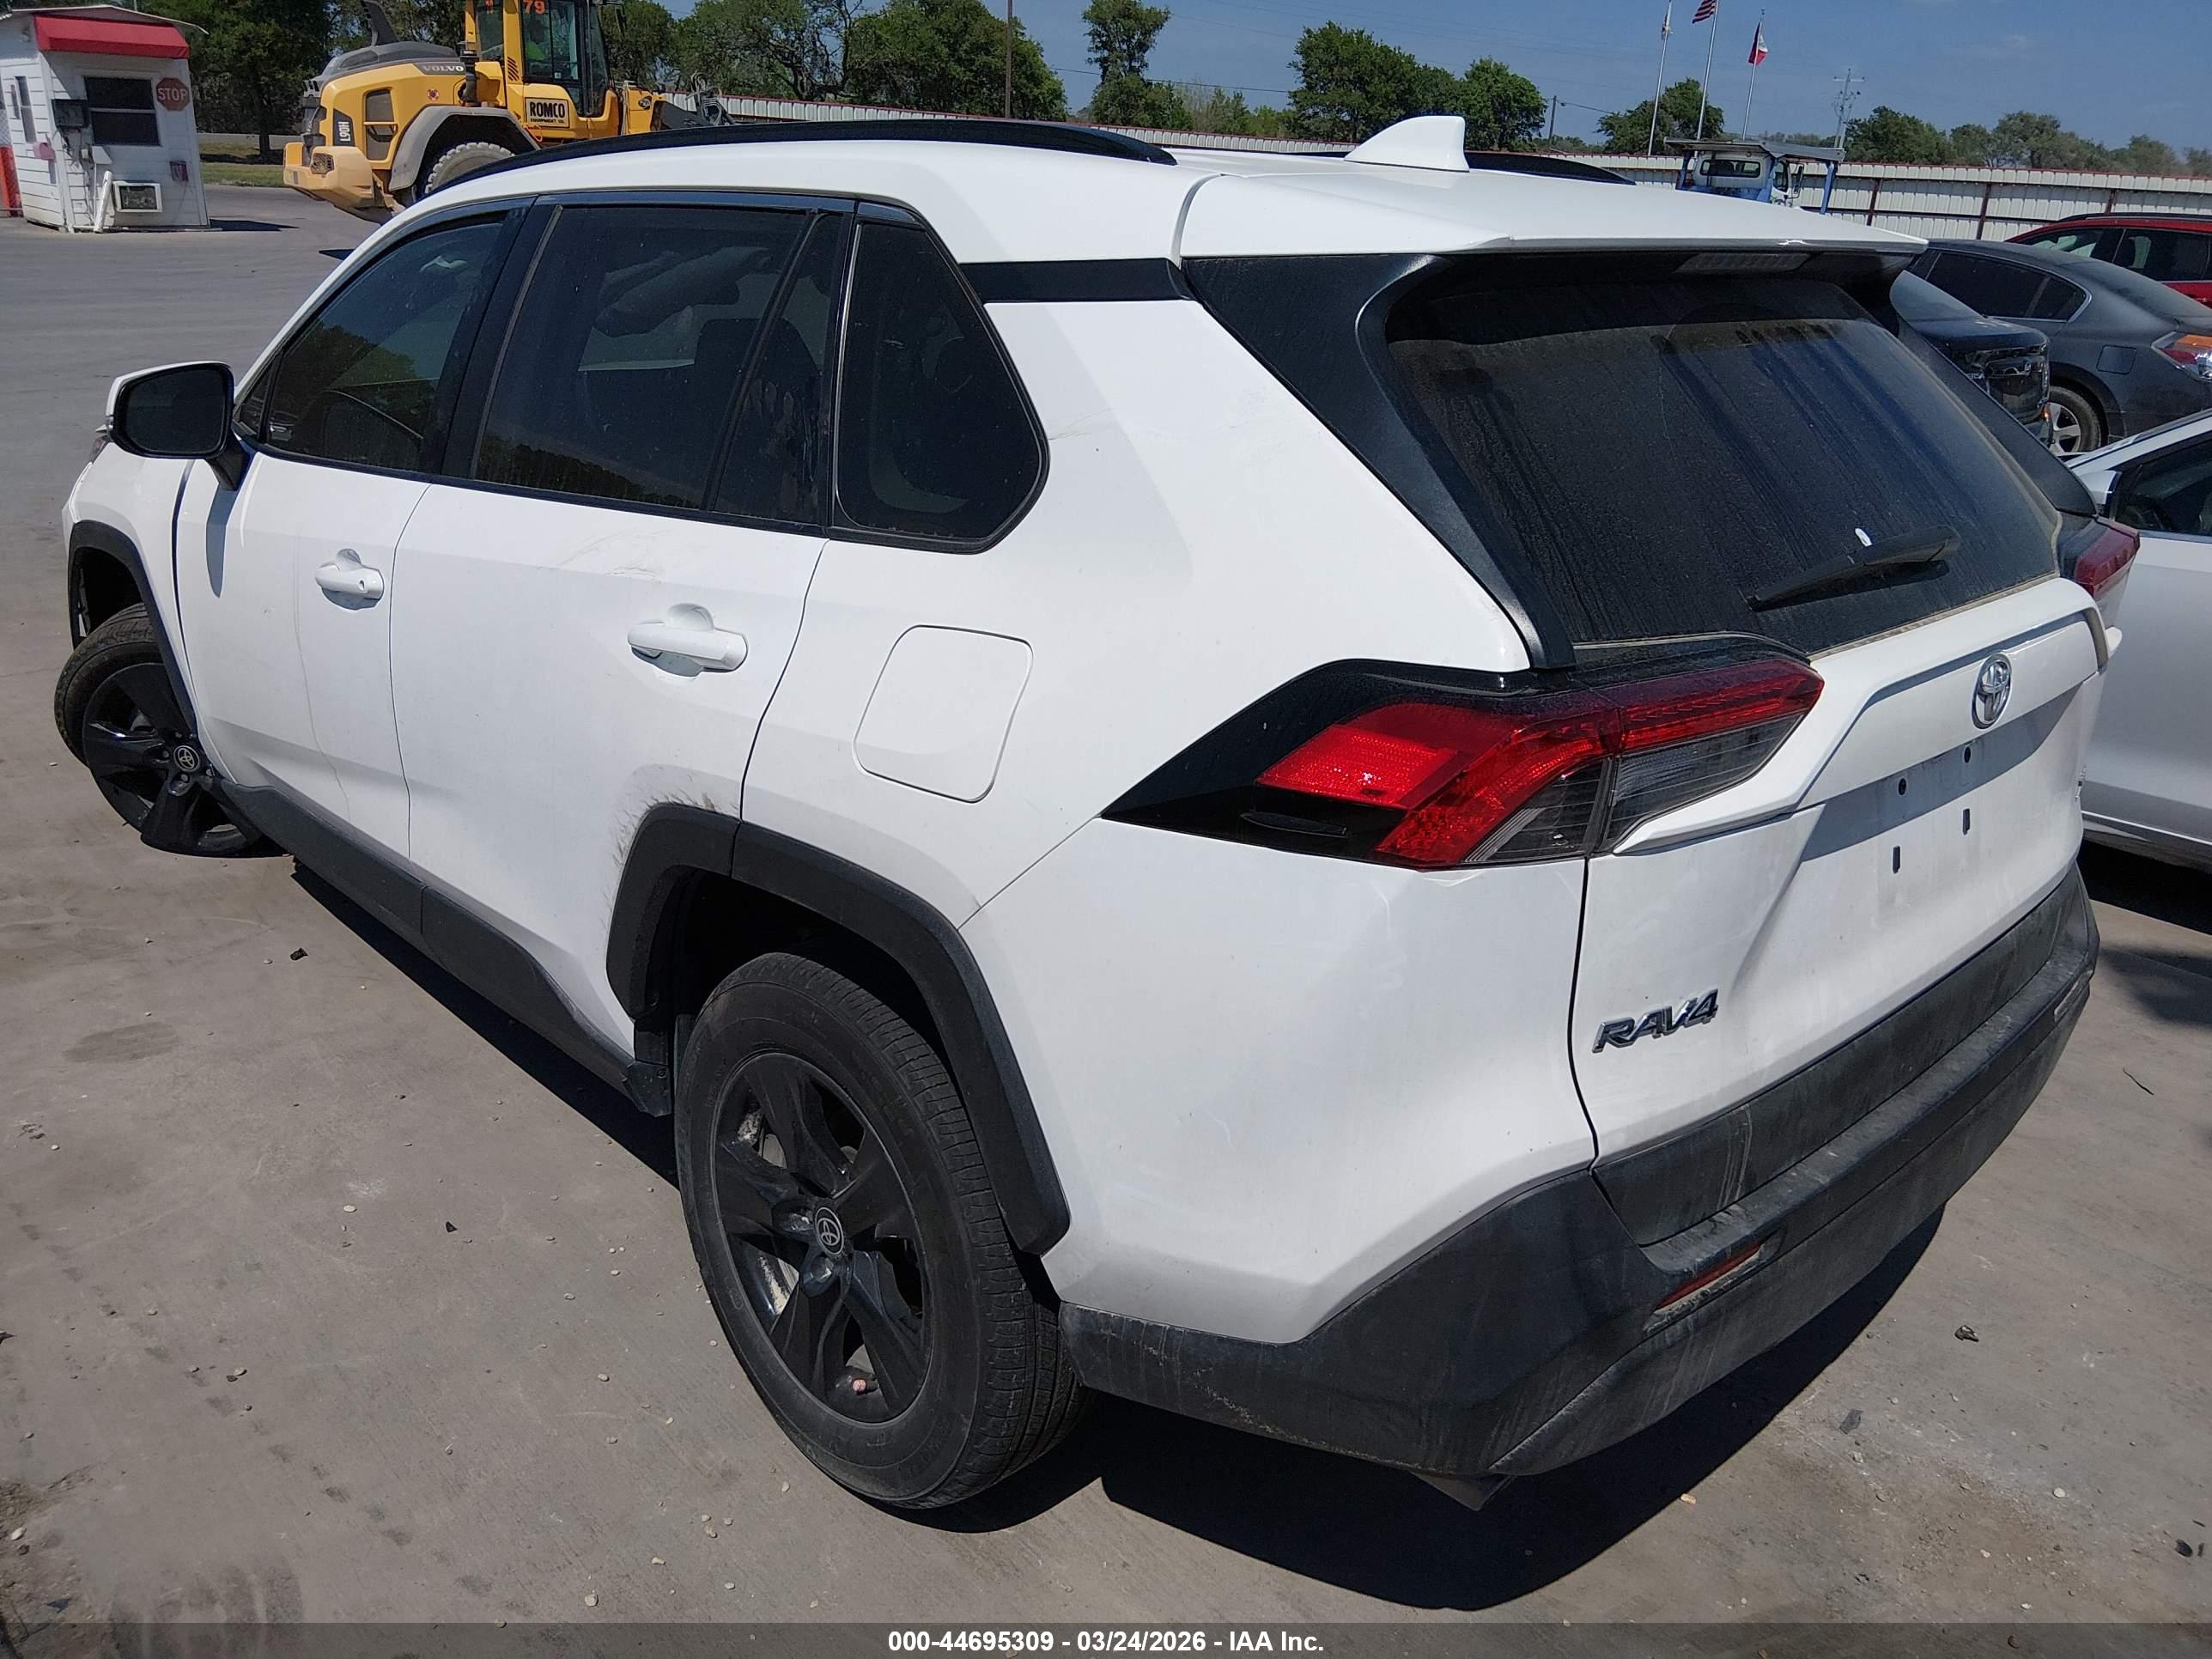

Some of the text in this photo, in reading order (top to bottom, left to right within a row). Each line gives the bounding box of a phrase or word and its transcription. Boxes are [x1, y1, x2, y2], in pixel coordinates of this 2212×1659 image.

[523, 0, 545, 14] 79
[158, 88, 187, 100] STOP
[529, 101, 565, 118] ROMCO
[338, 121, 351, 142] L90H
[1592, 988, 1719, 1054] RAV4
